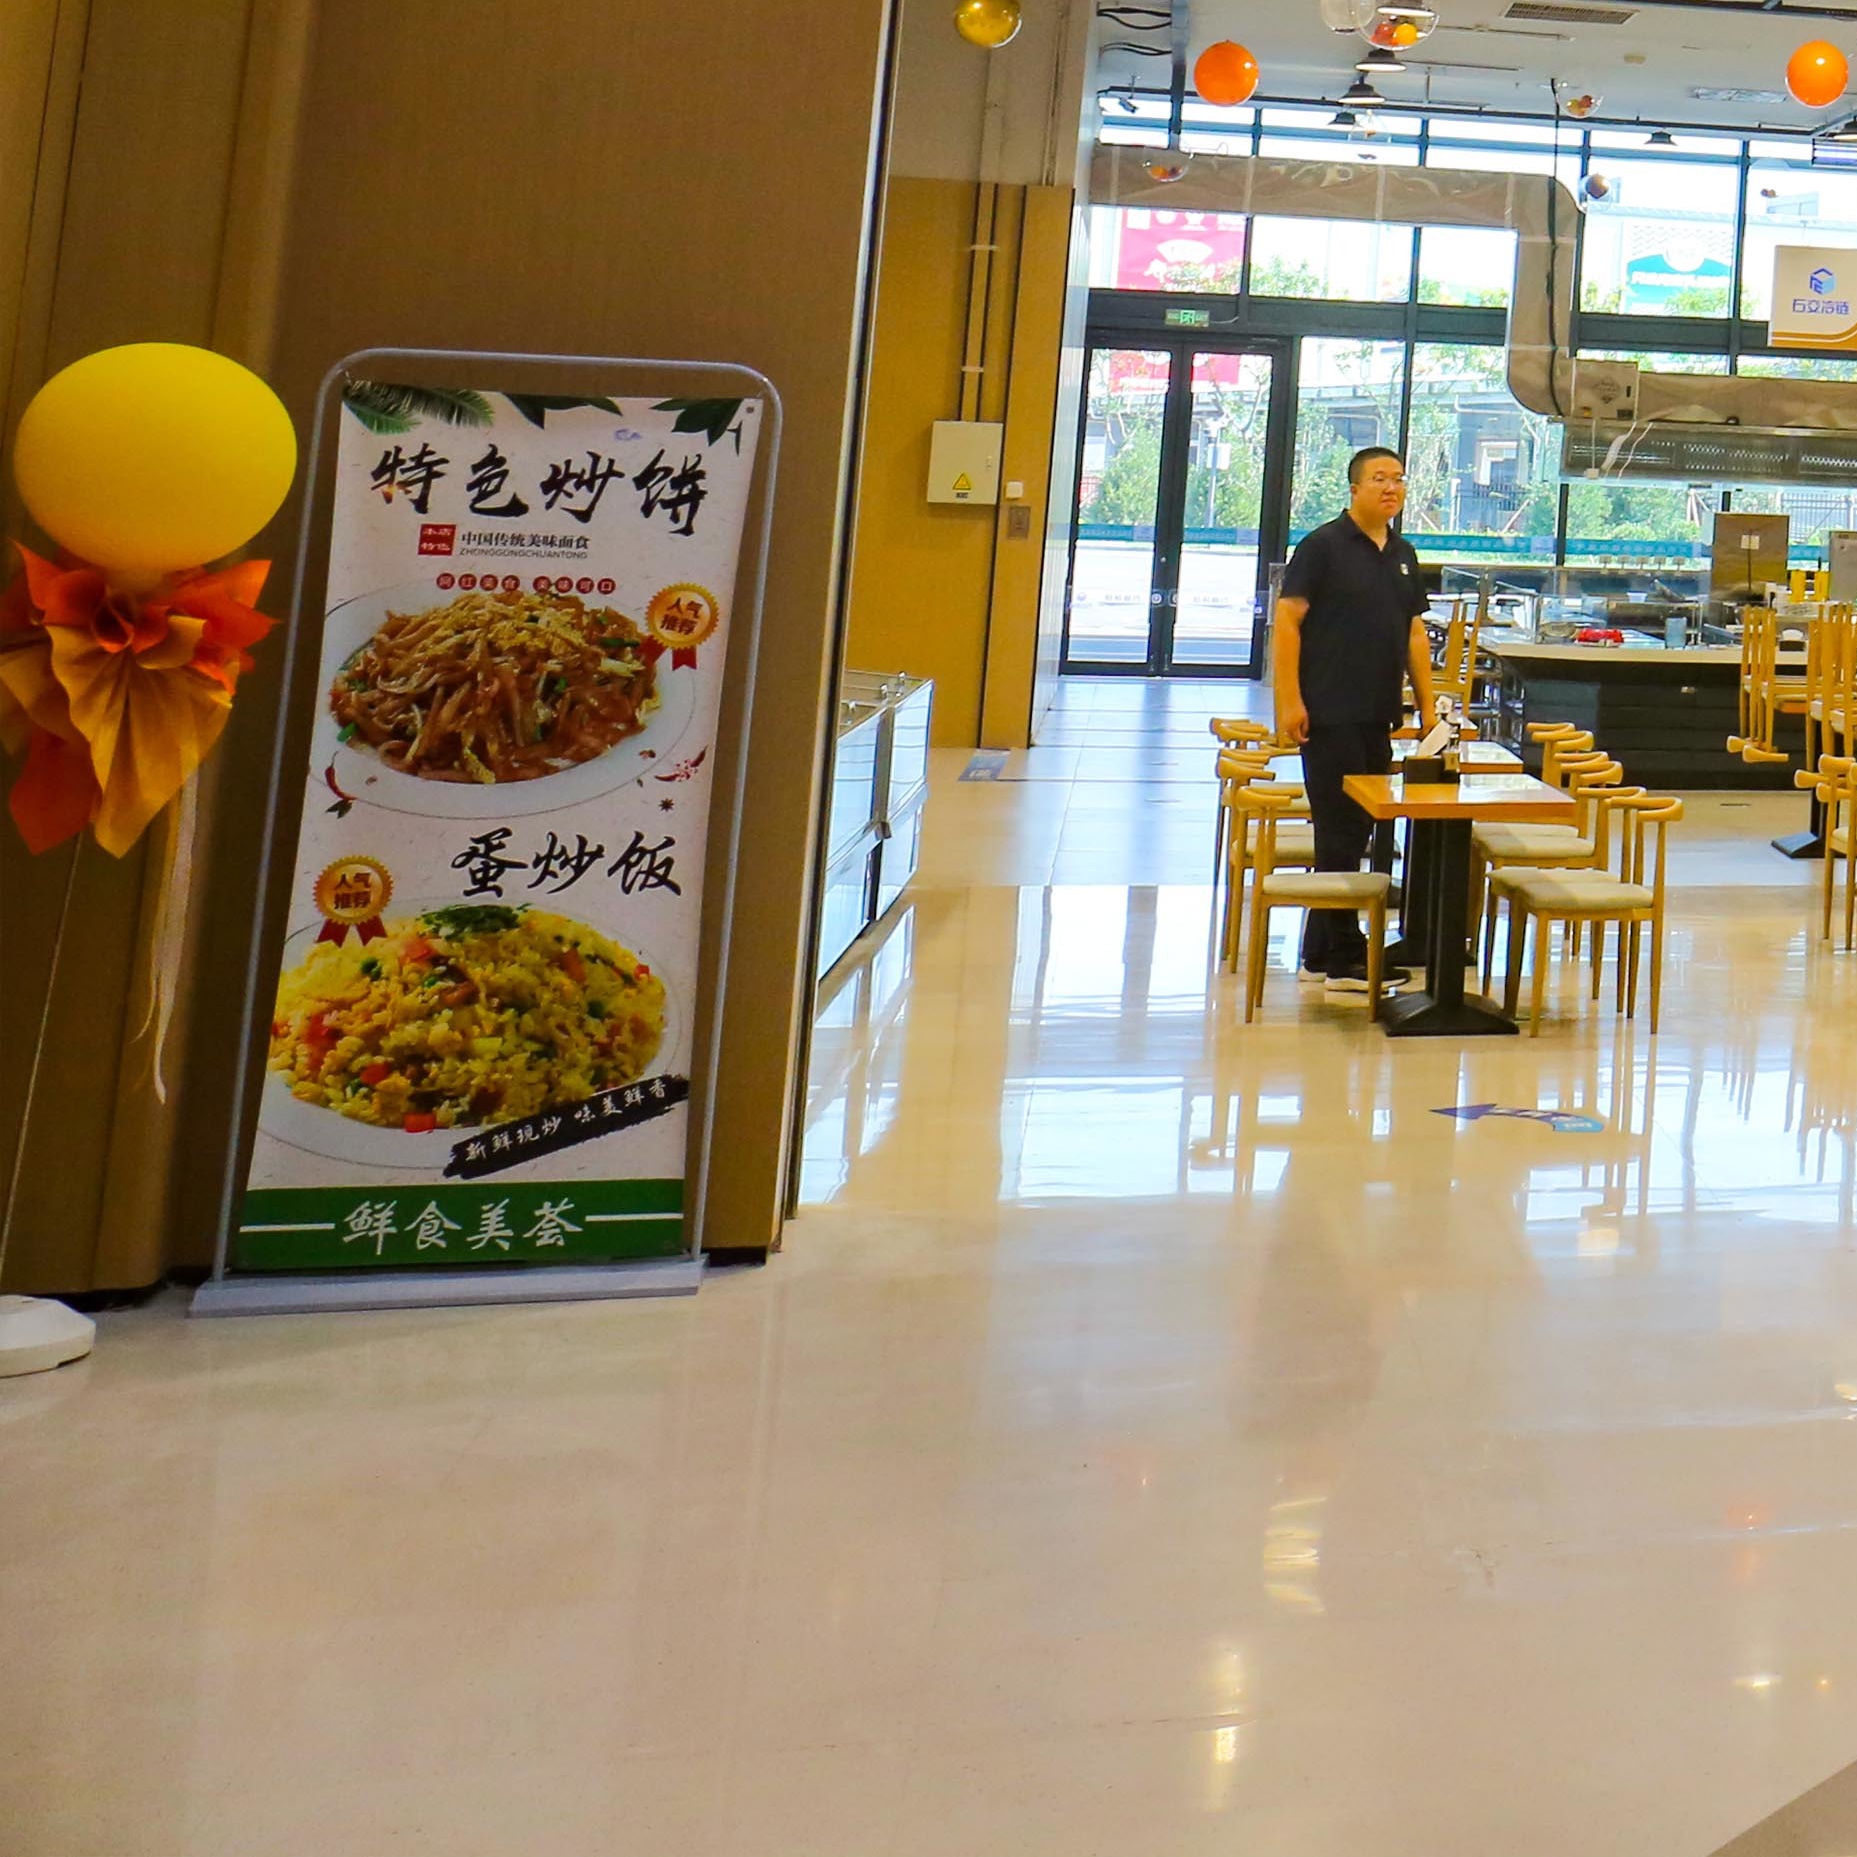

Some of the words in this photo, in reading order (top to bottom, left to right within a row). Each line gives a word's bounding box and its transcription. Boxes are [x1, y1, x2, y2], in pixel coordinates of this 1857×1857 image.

[370, 443, 709, 536] 特色炒饼
[461, 530, 591, 551] 中国传统美味面食
[666, 596, 704, 620] 人气
[451, 827, 682, 898] 蛋炒饭
[334, 871, 371, 891] 人气
[333, 890, 372, 910] 推荐
[342, 1198, 584, 1256] 鲜食美荟
